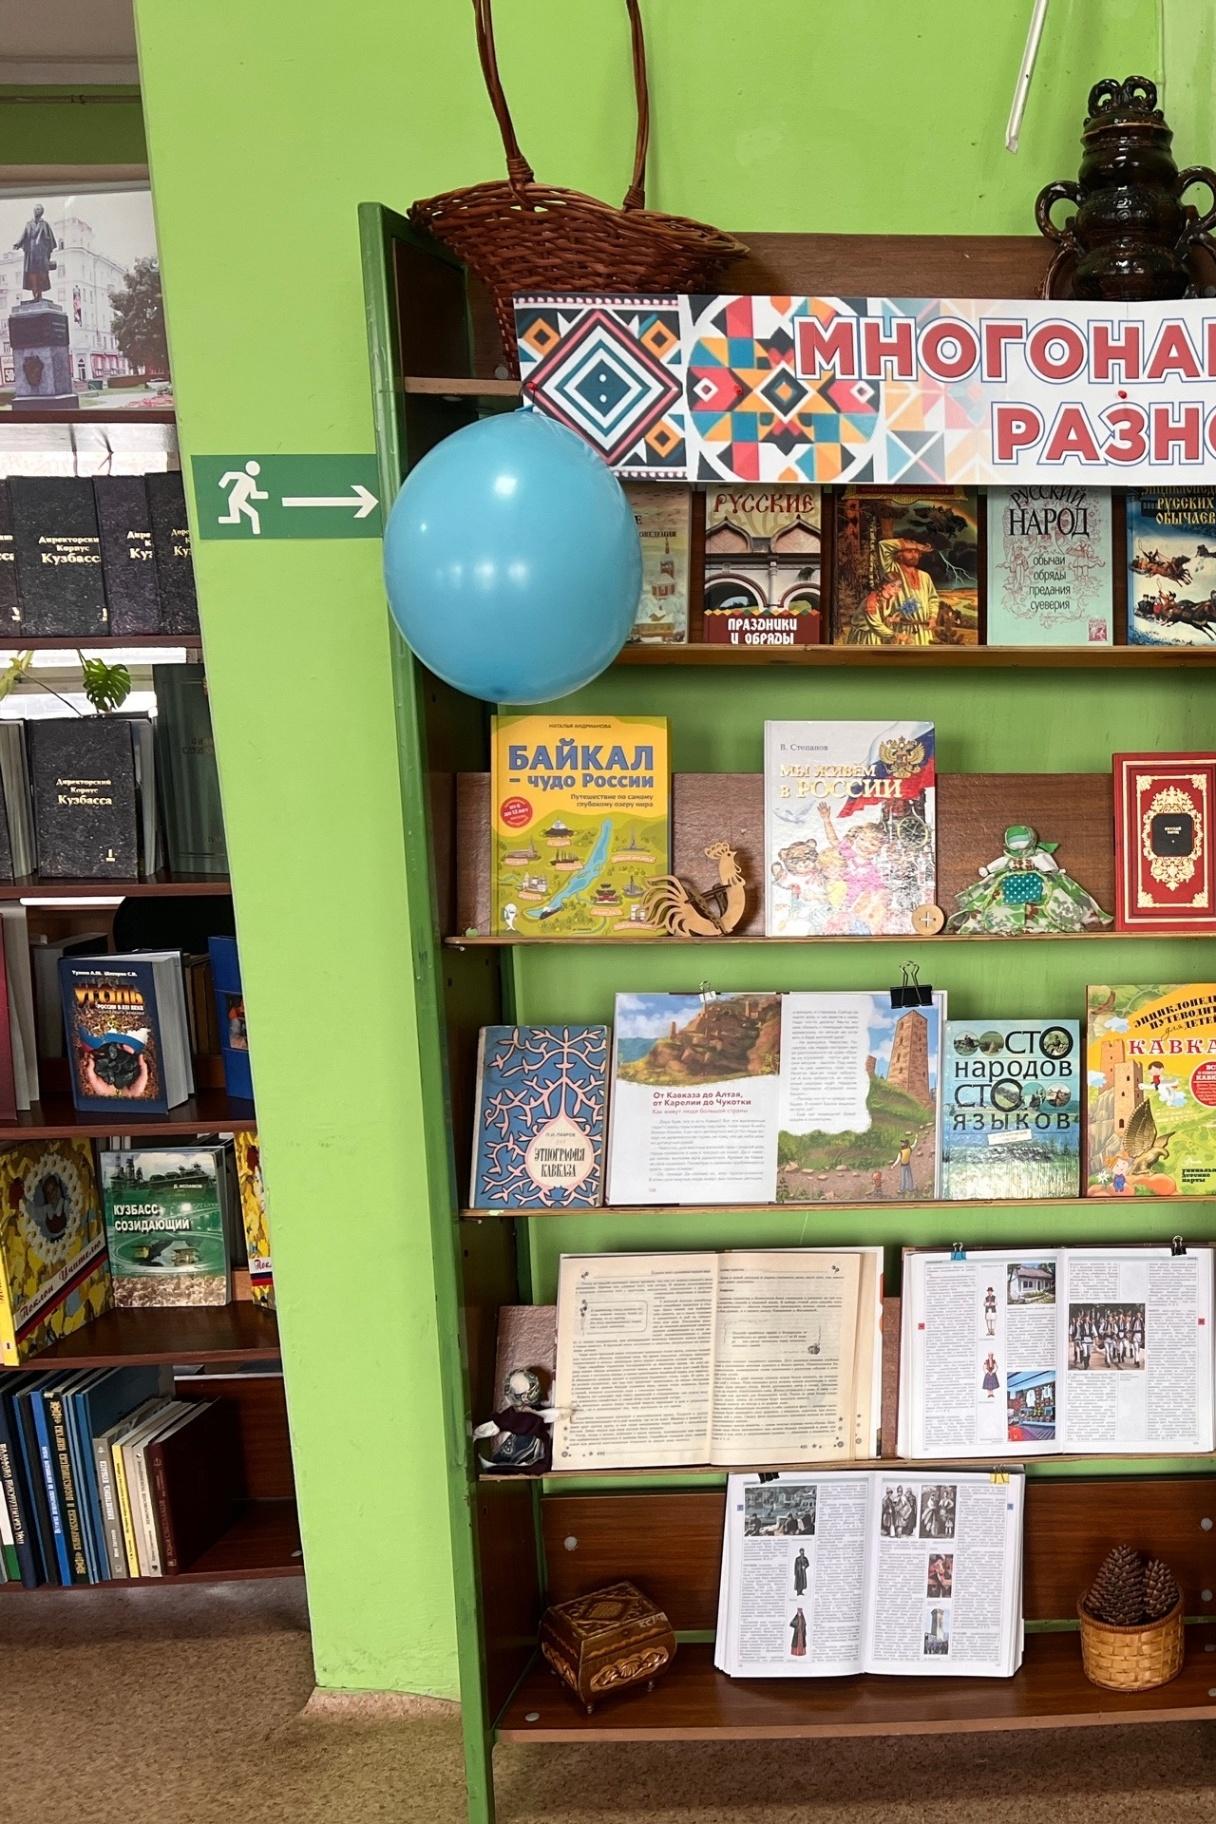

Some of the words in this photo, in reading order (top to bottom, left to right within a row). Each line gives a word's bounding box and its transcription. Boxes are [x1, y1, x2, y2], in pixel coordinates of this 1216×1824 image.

[713, 493, 815, 514] РУССКИЕ
[1157, 496, 1215, 510] РУССКИХ
[1009, 507, 1090, 537] НАРОД
[1155, 510, 1216, 525] ОБЫЧАЕВ
[39, 535, 100, 545] Директорски
[42, 552, 101, 566] Кузбасс
[1032, 555, 1066, 567] обычаи
[1032, 569, 1067, 582] обряды
[1029, 584, 1071, 597] предания
[1030, 600, 1070, 611] суеверия
[727, 617, 797, 632] ПРАЗДНИКИ
[508, 738, 654, 771] БАЙКАЛ
[527, 774, 576, 791] чудо
[582, 773, 655, 788] России
[796, 778, 903, 799] РОССИИ
[58, 795, 113, 806] Кузбасса
[1004, 1026, 1074, 1060] СТО
[955, 1060, 1073, 1082] народов
[653, 1091, 665, 1099] От
[666, 1091, 701, 1099] Кавказа
[954, 1077, 1024, 1112] СТО
[664, 1099, 701, 1107] Карелии
[702, 1099, 714, 1107] до
[716, 1098, 752, 1107] Чукотки
[952, 1112, 1071, 1131] языков
[534, 1147, 586, 1162] ЭТНОГРАФИЯ
[540, 1163, 577, 1178] КАВКАЗА
[113, 1203, 159, 1216] КУЗБАСС
[114, 1220, 190, 1232] СОЗИДАЮЩИЙ
